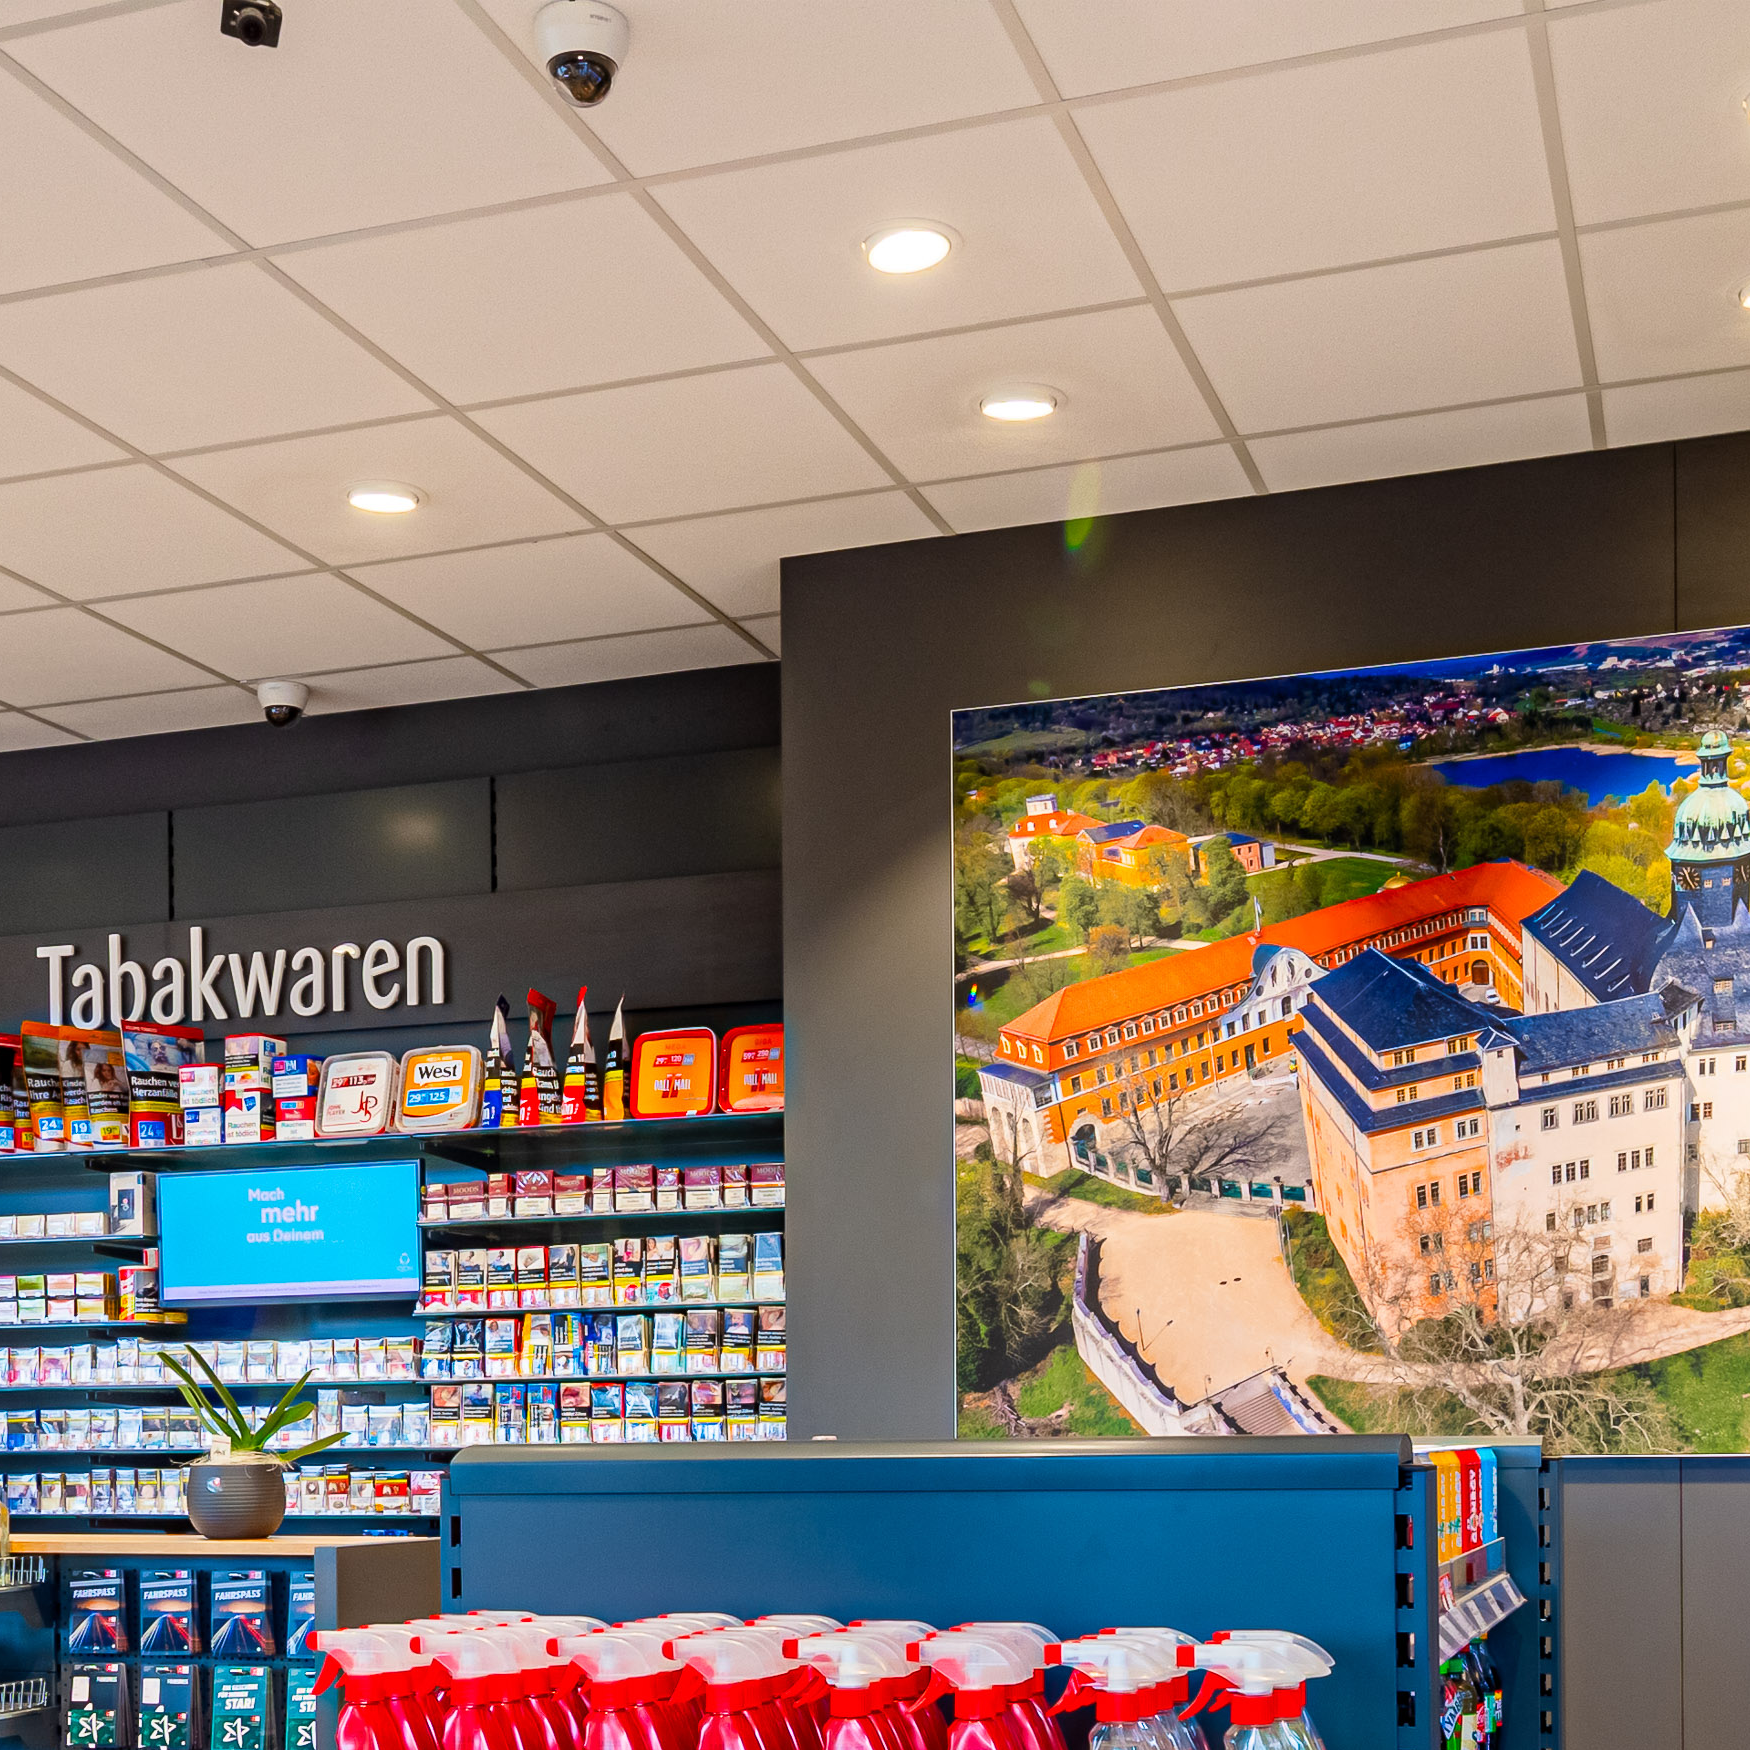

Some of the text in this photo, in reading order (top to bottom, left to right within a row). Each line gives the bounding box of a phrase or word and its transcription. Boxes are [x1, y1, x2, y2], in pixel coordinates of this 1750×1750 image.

[36, 926, 445, 1030] Tabakwaren
[418, 1064, 458, 1081] West
[132, 1077, 167, 1087] Rauchen
[654, 1079, 691, 1091] PALL MALL
[744, 1073, 778, 1086] PALL MALL
[133, 1088, 178, 1099] Herzanfälle
[248, 1187, 284, 1201] Mach
[453, 1186, 479, 1194] MOODS
[261, 1200, 319, 1223] mehr
[247, 1229, 324, 1243] aus Deinem
[73, 1588, 116, 1599] FAHRSPASS
[144, 1589, 188, 1600] FAHRSPASS
[215, 1589, 261, 1600] FAHRSPASS
[225, 1698, 256, 1709] STAR!
